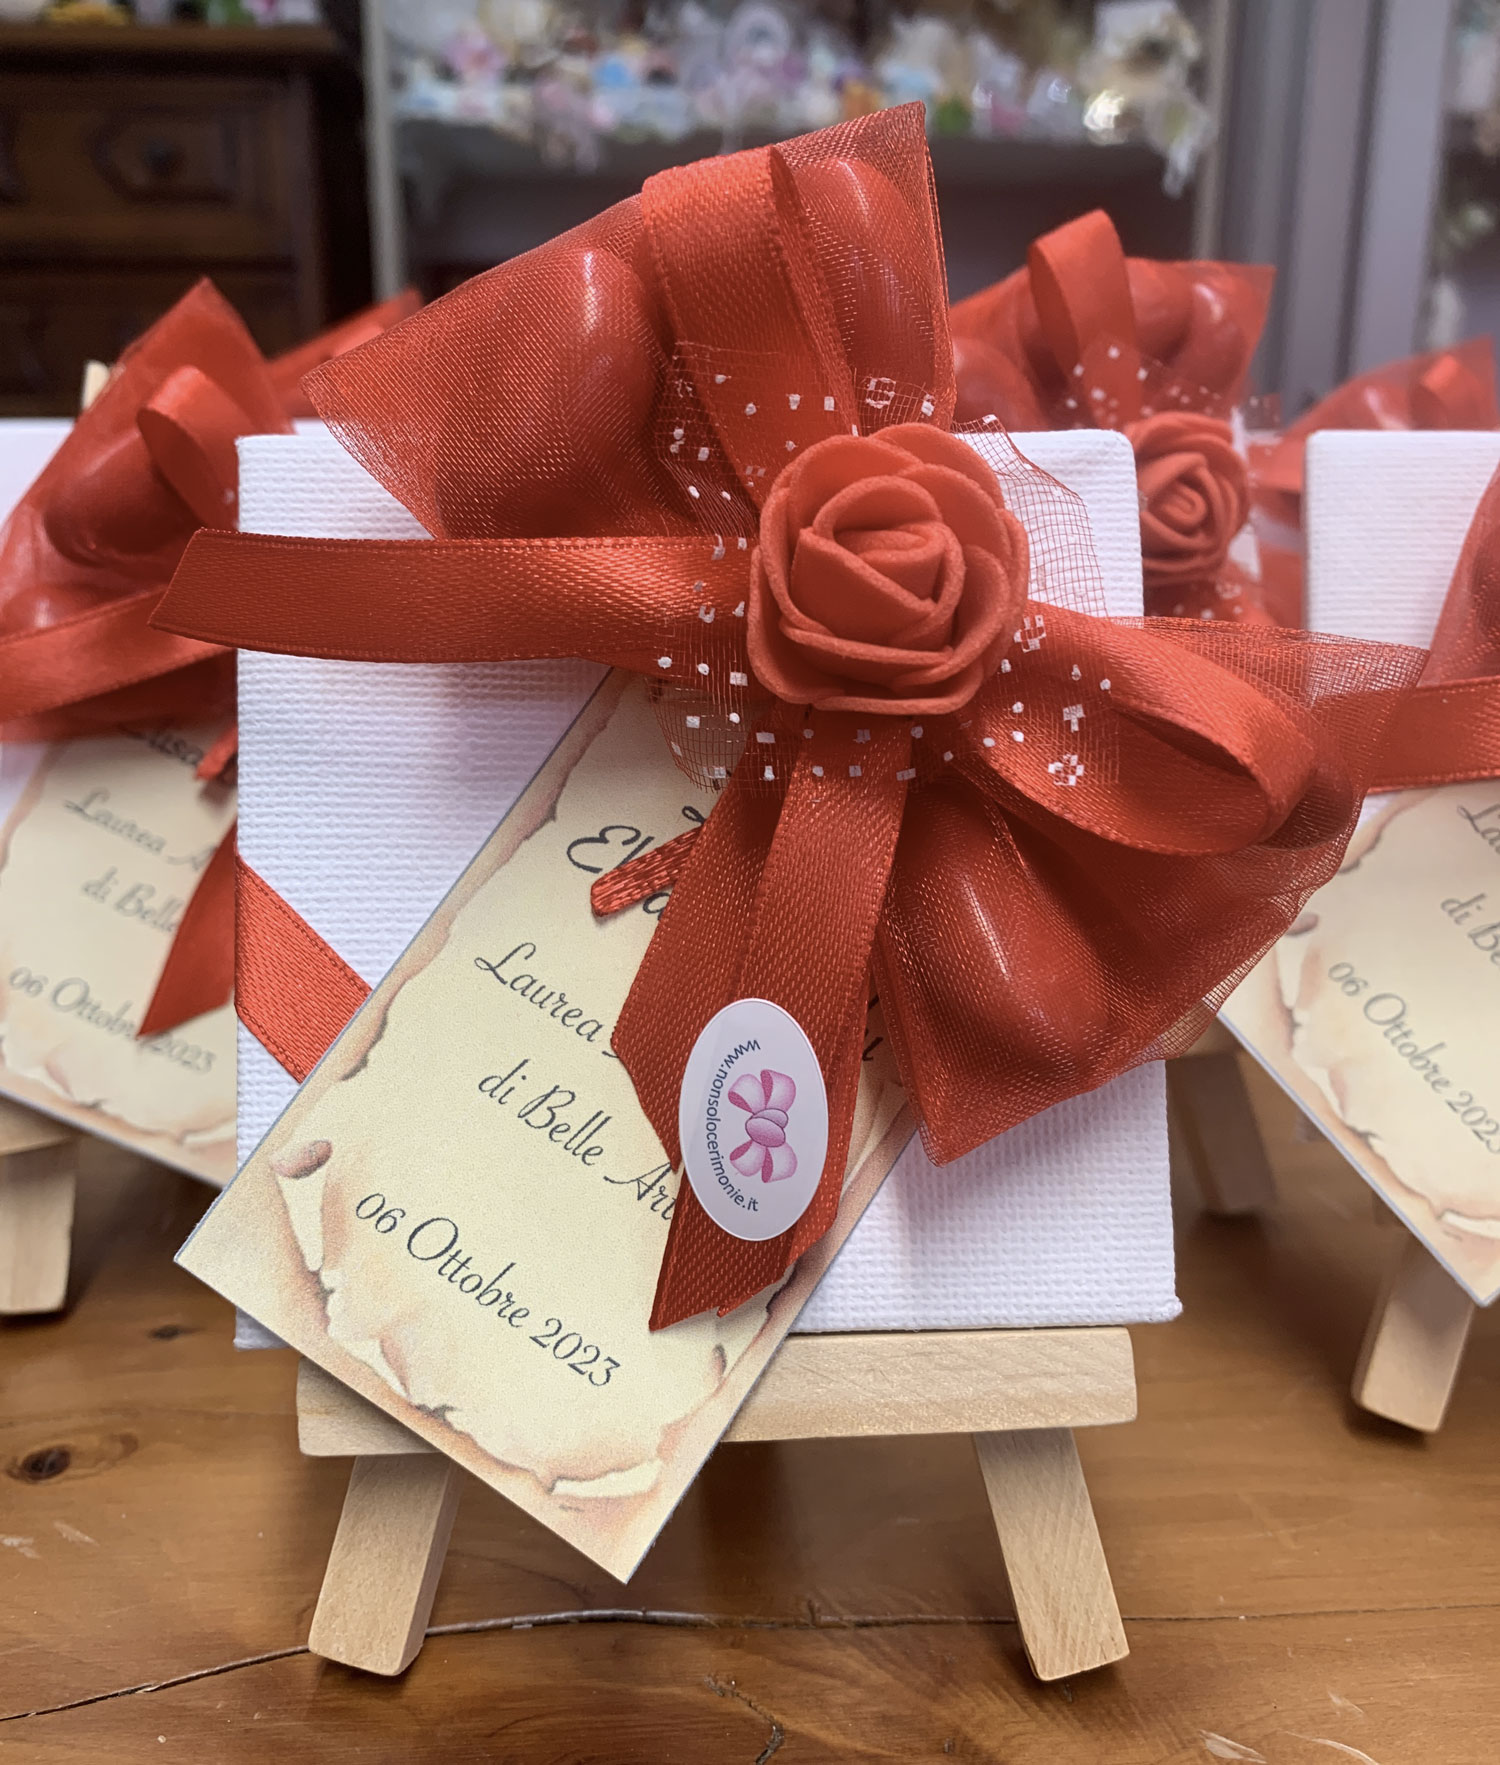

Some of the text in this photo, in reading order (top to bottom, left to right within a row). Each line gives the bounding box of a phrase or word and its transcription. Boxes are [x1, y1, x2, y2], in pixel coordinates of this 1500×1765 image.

[81, 865, 118, 904] di
[1440, 892, 1486, 925] di
[9, 966, 48, 999] 06
[474, 942, 601, 1042] Laurea
[1327, 961, 1368, 998] 06
[1362, 992, 1452, 1095] Ottobre
[478, 1059, 530, 1105] di
[517, 1085, 613, 1167] Belle
[706, 1039, 761, 1212] www.nonsolocerimonie.it
[355, 1192, 621, 1387] 06 Ottobre 2023
